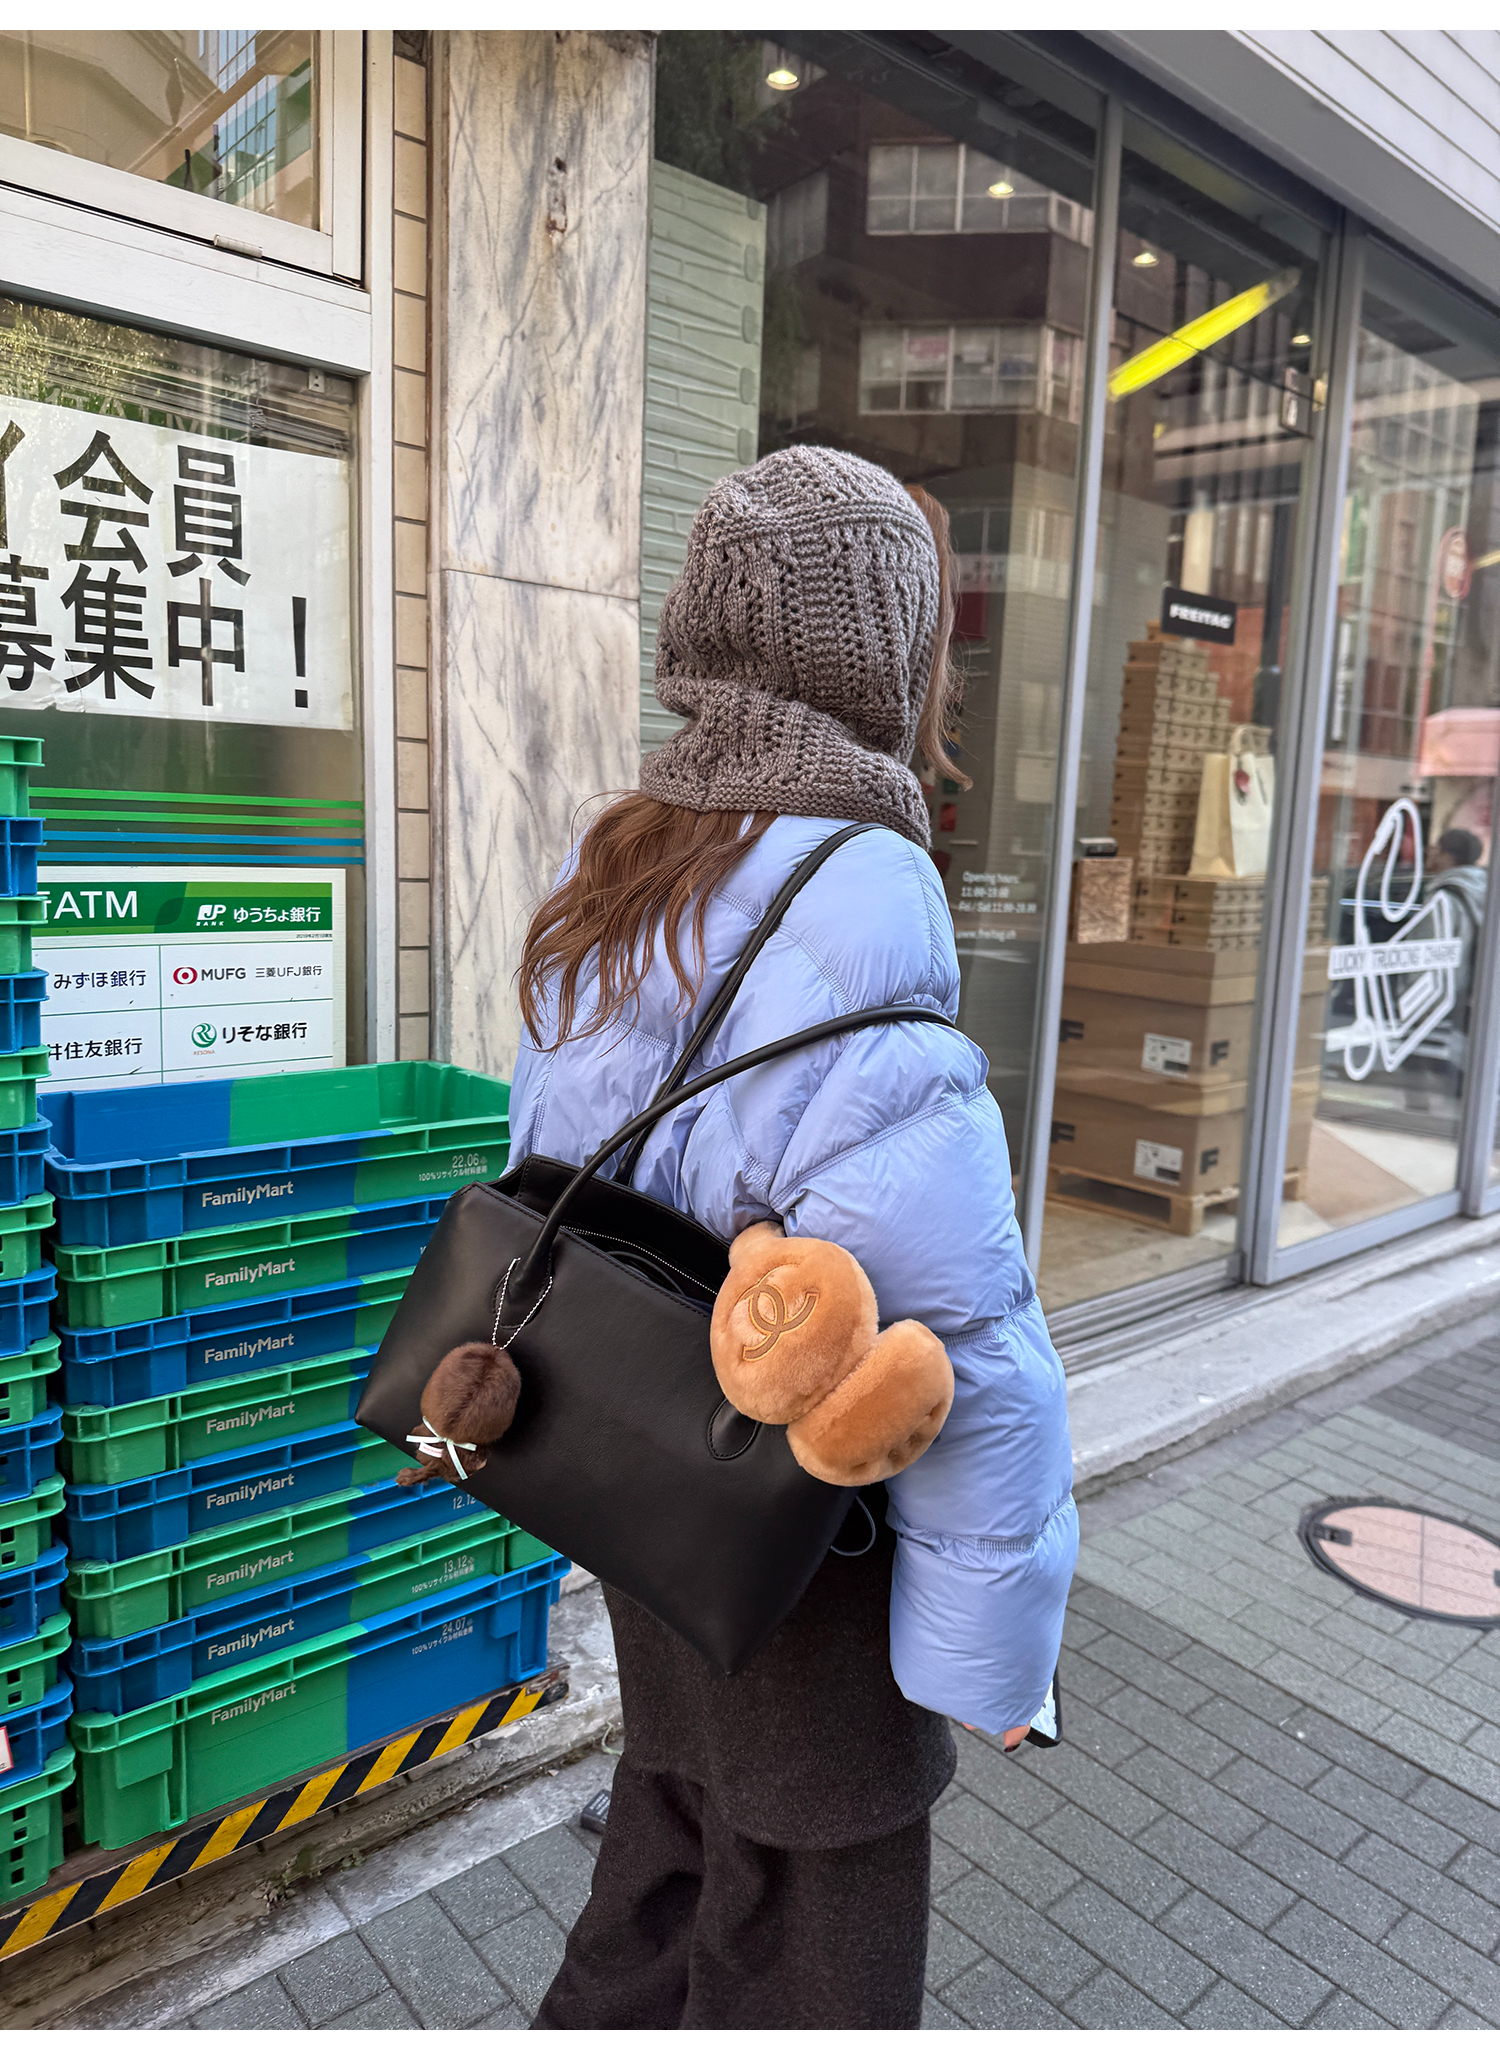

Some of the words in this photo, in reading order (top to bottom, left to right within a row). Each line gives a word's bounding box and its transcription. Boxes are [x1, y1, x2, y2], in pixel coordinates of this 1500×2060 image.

[1169, 603, 1232, 629] FREITAG
[962, 870, 996, 885] Opening
[233, 907, 321, 923] ゆうちょ銀行
[54, 969, 146, 989] みずほ銀行
[201, 967, 246, 981] MUFG
[255, 965, 322, 978] 三菱UFJ銀行
[222, 1022, 307, 1044] りそな銀行
[452, 1153, 479, 1169] 22.06
[202, 1181, 294, 1208] FamilyMart
[205, 1258, 296, 1288] FamilyMart
[204, 1333, 295, 1364] FamilyMart
[206, 1401, 295, 1434] FamilyMart
[206, 1473, 295, 1509] FamilyMart
[206, 1550, 294, 1589] FamilyMart
[443, 1555, 467, 1574] 13.12
[207, 1619, 295, 1660] FamilyMart
[442, 1616, 466, 1637] 24.07
[211, 1683, 297, 1725] FamilyMart
